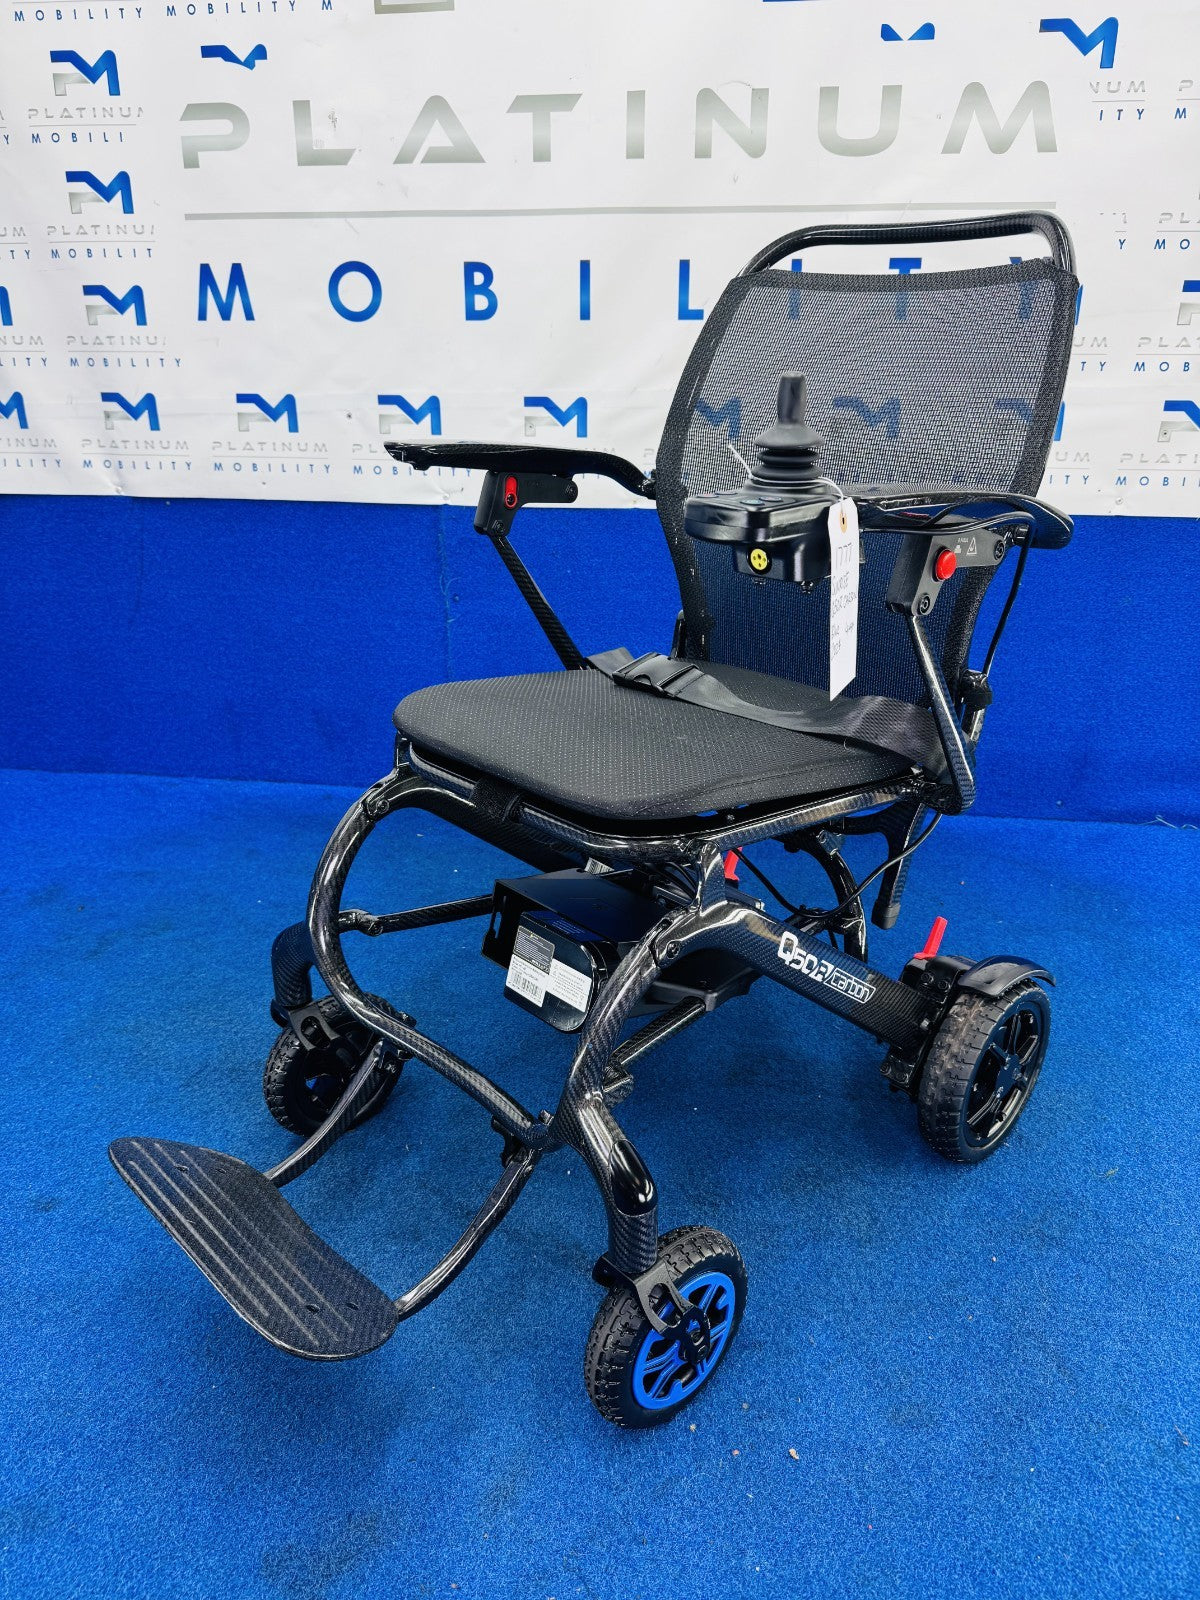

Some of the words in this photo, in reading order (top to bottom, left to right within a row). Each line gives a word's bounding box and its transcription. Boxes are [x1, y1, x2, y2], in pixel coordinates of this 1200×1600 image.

[166, 0, 296, 16] MOBILITY
[14, 7, 142, 22] MOBILITY
[179, 81, 1058, 169] PLATINUM
[46, 224, 155, 236] PLATINU
[197, 257, 1041, 322] MOBILITY
[66, 335, 167, 346] PLATINU
[70, 357, 182, 368] MOBILITY
[81, 439, 190, 450] PLATINUM
[211, 441, 329, 453] PLATINUM
[83, 459, 192, 471] MOBILITY
[213, 462, 331, 474] MOBILITY
